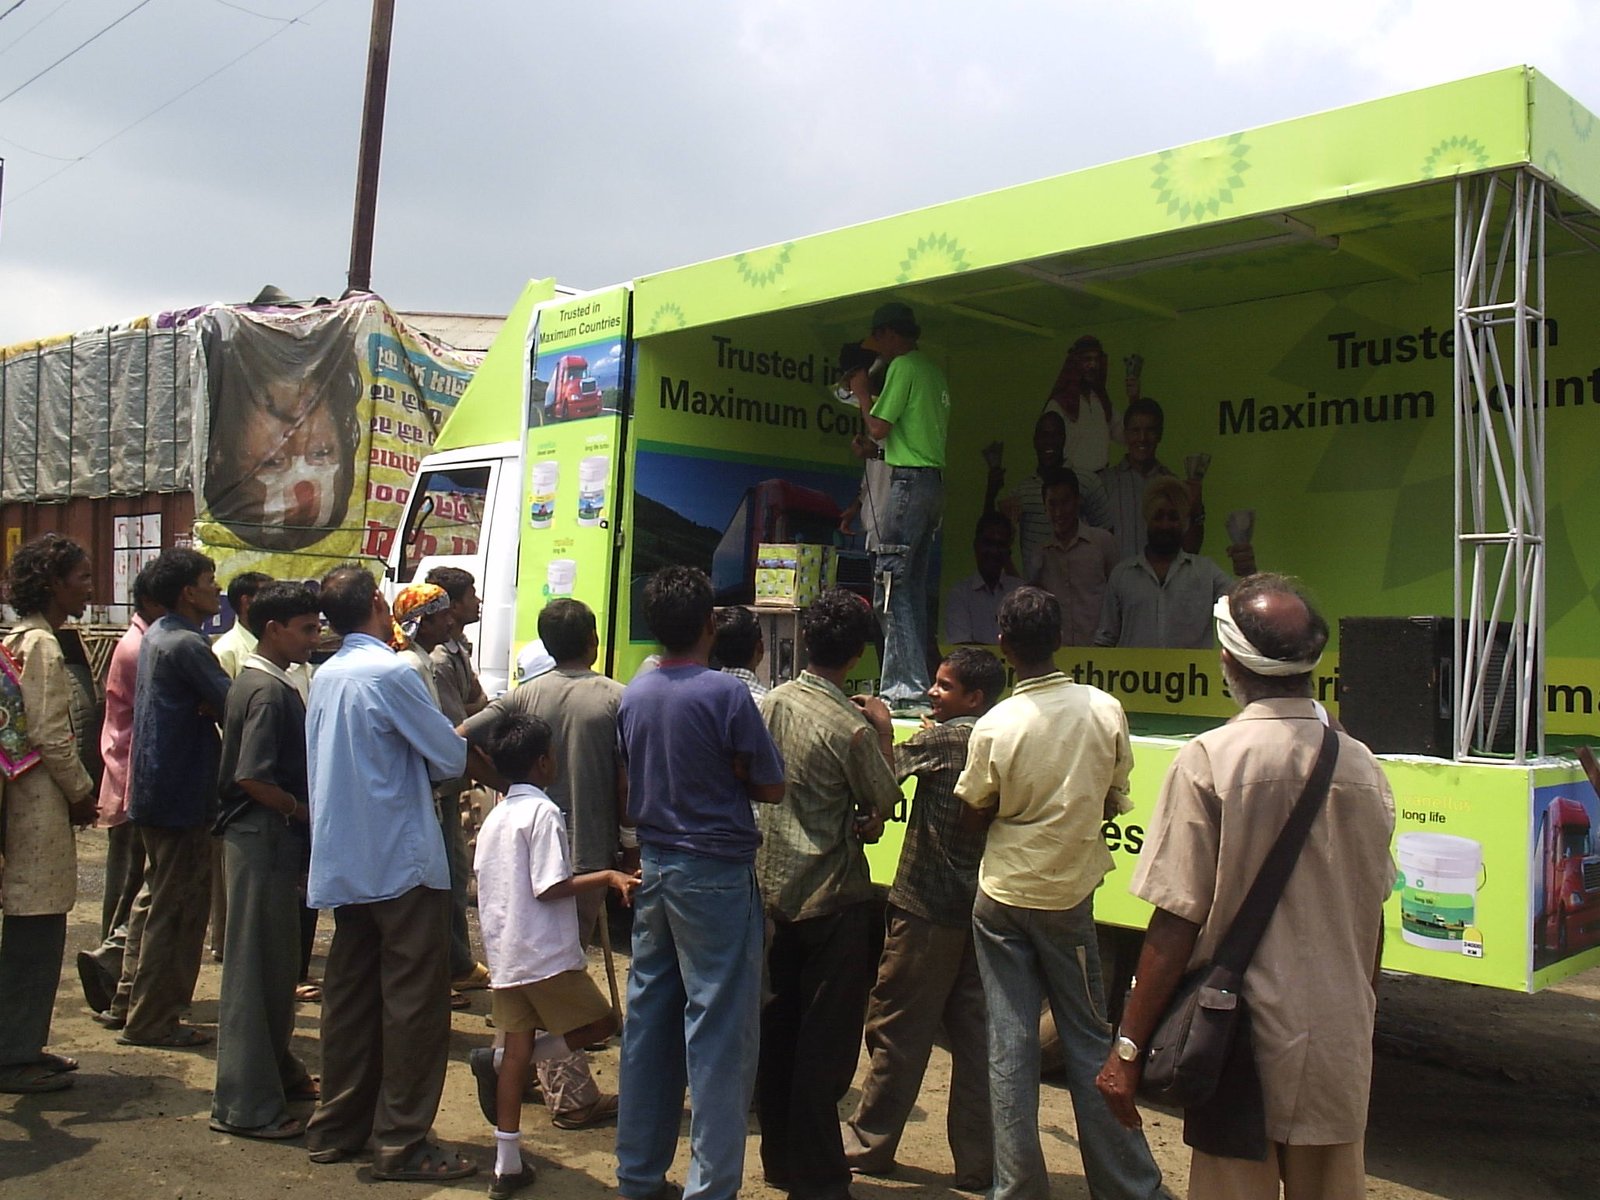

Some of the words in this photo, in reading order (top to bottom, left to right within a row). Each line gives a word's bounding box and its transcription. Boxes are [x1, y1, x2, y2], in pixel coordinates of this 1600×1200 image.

[540, 327, 577, 344] Maximum
[579, 316, 621, 335] Countries
[560, 303, 591, 322] Trusted
[592, 302, 601, 314] in
[712, 335, 814, 386] Trusted
[660, 376, 808, 430] Maximum
[1219, 389, 1435, 435] Maximum
[1071, 661, 1208, 703] through
[1402, 809, 1426, 823] long
[1429, 811, 1446, 823] life
